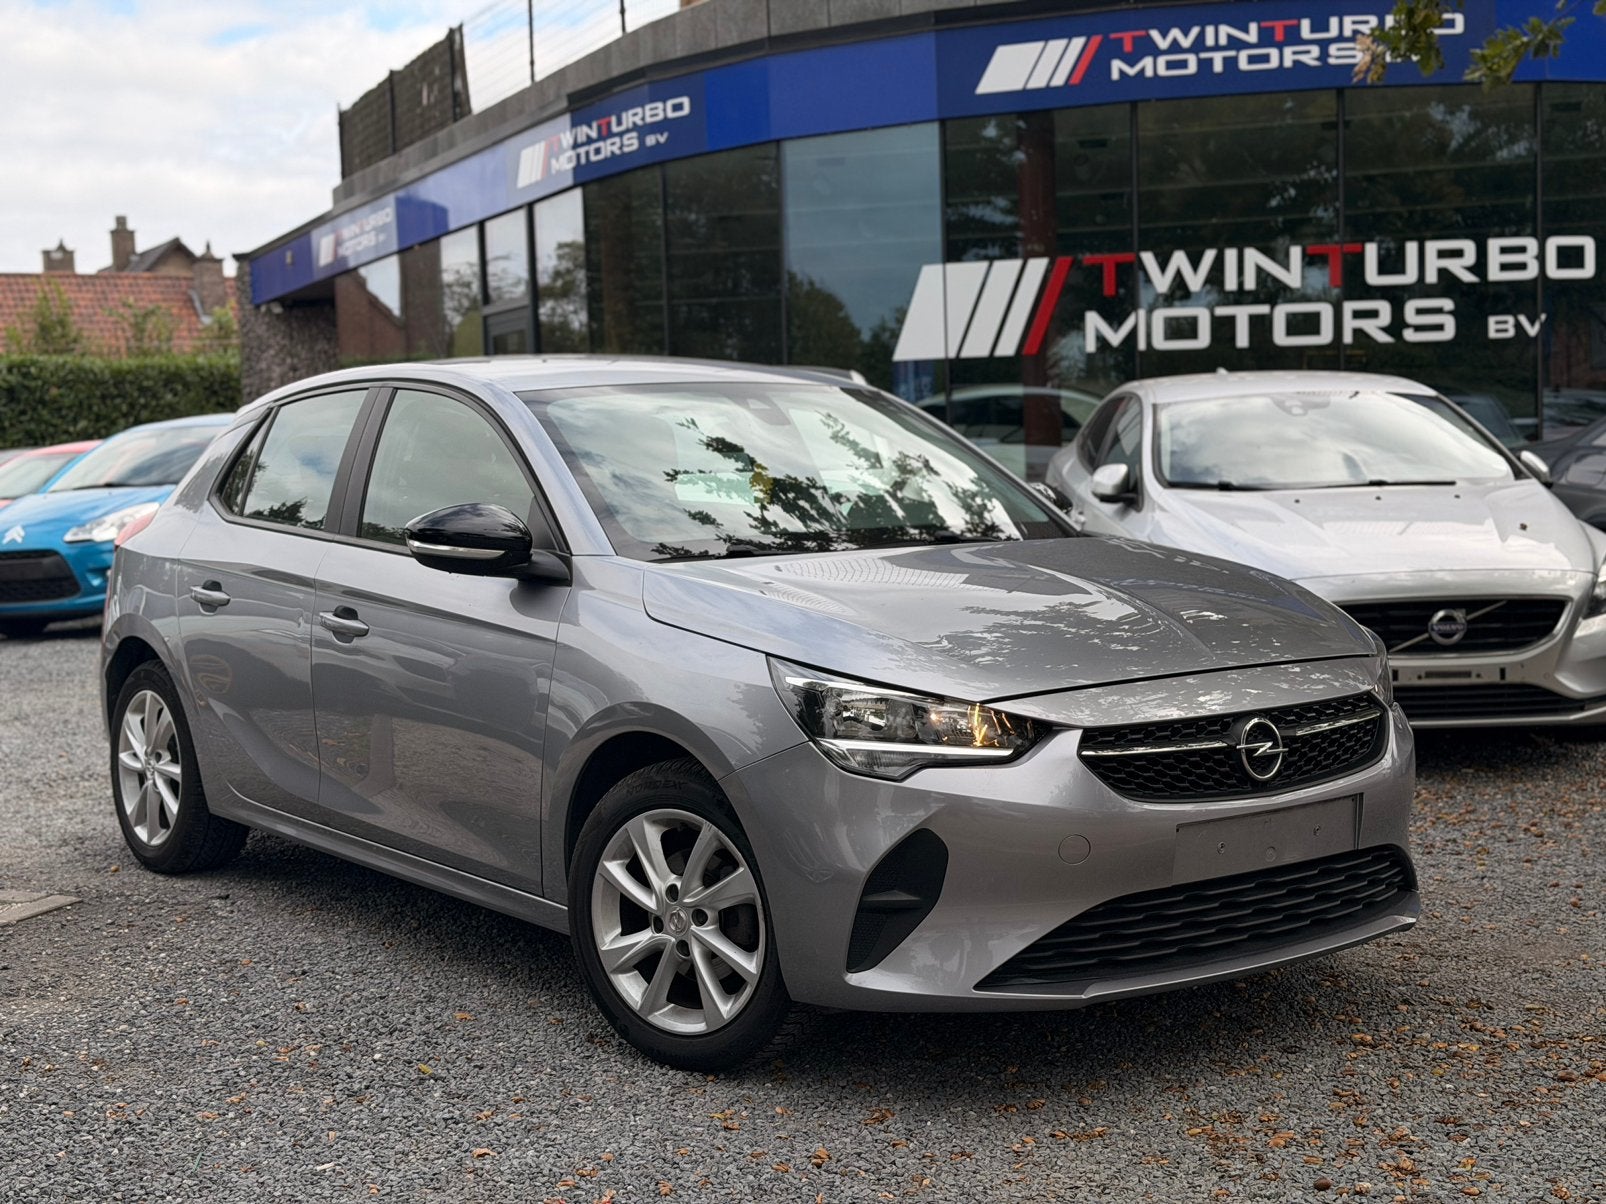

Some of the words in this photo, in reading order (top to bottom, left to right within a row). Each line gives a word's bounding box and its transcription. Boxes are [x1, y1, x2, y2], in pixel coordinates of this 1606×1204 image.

[1109, 12, 1465, 54] TWINTURO
[1110, 42, 1363, 81] MOTORS
[549, 95, 692, 152] TWINTURBO
[551, 131, 640, 174] MOTORS
[645, 132, 669, 147] BV
[1083, 235, 1597, 297] TWINTURBO
[1085, 298, 1457, 354] MOTORS
[1487, 313, 1547, 340] BV
